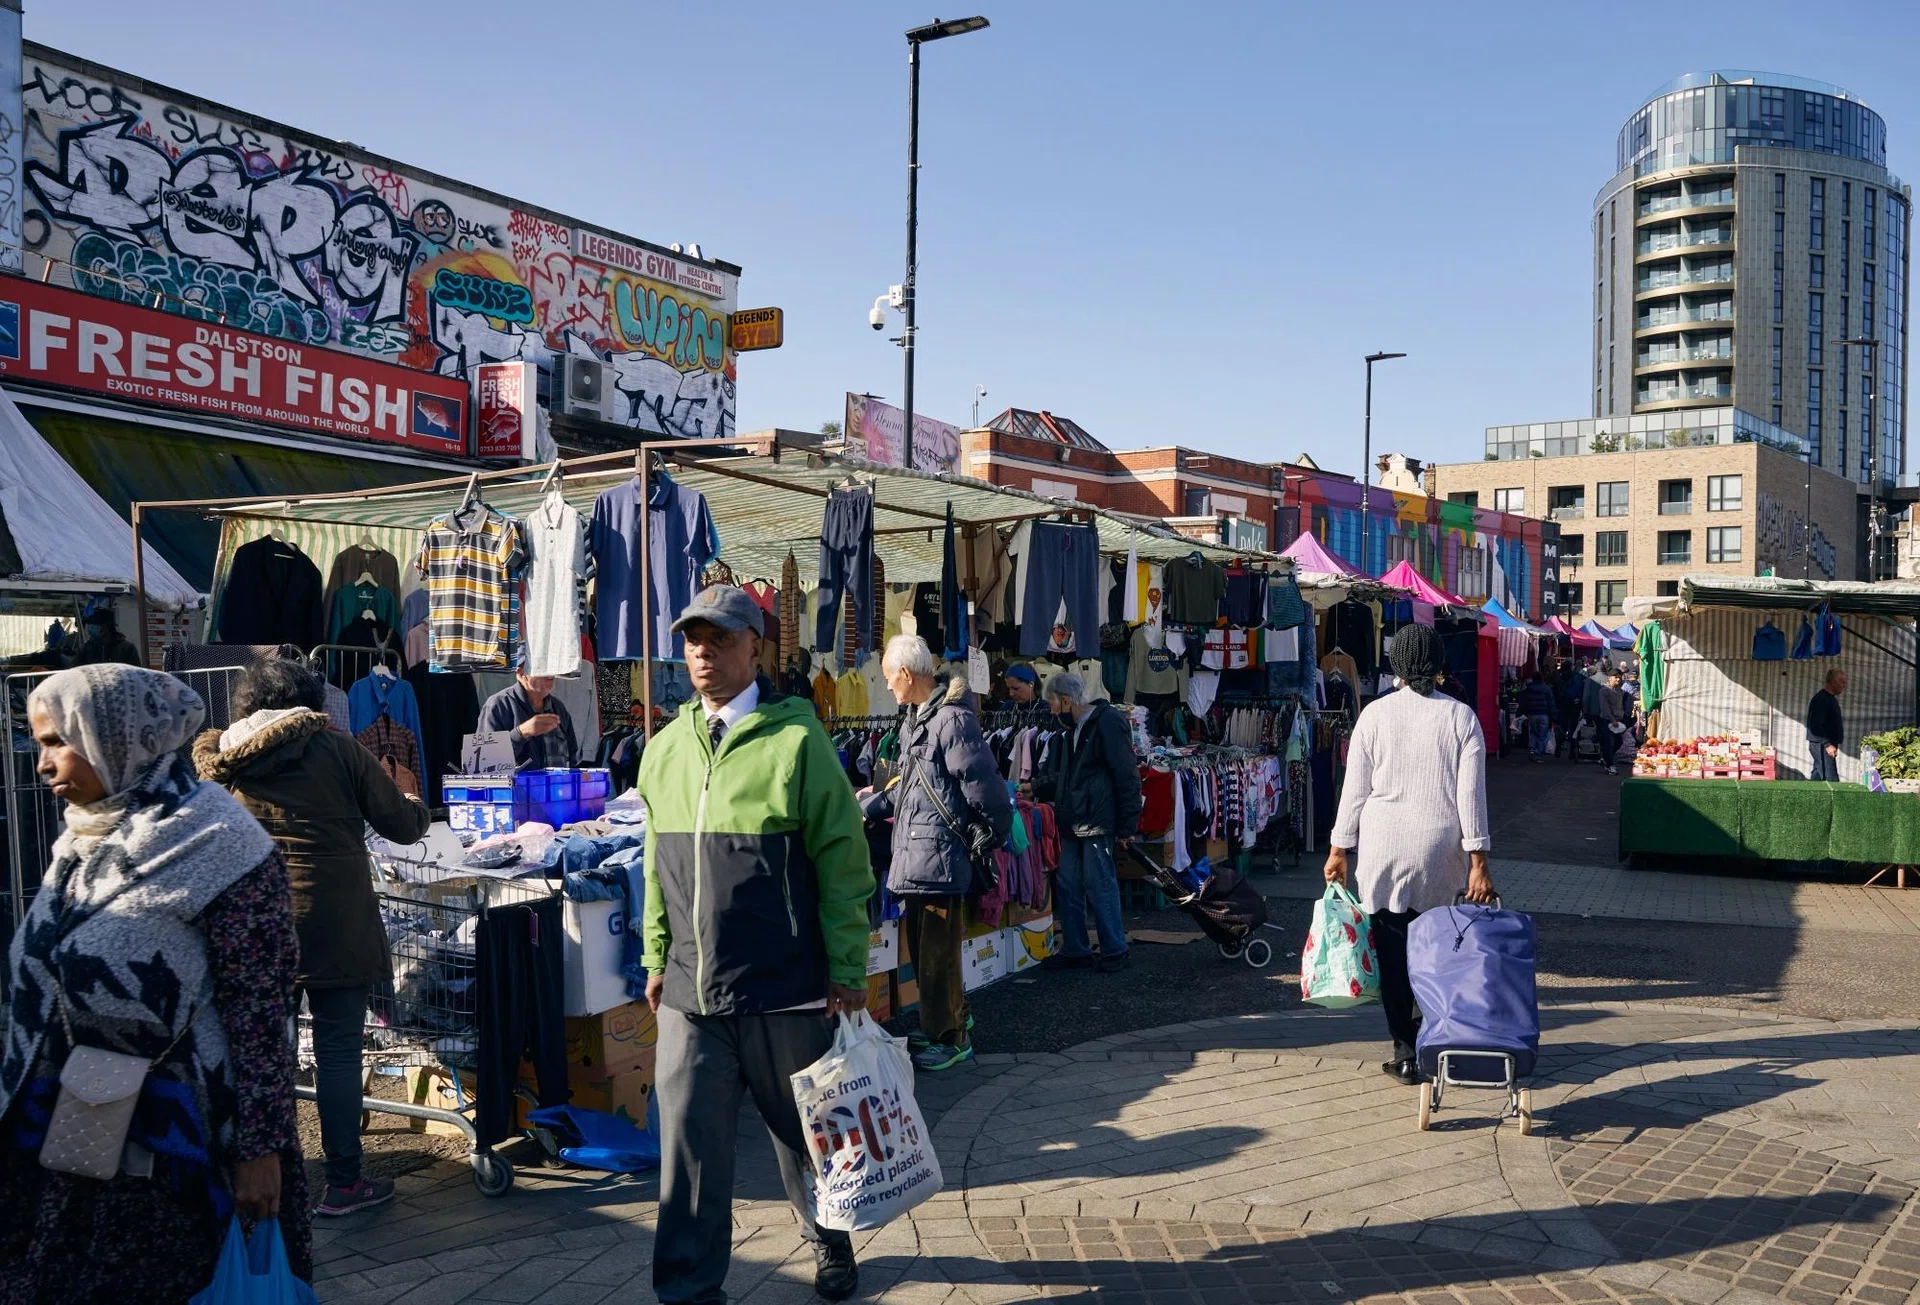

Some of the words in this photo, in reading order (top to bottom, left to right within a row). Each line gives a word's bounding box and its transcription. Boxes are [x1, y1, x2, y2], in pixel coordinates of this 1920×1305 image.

[582, 233, 643, 271] LEGENDS
[646, 255, 677, 282] GYM
[678, 276, 701, 288] FITNESS
[701, 280, 722, 295] CENTRE
[686, 265, 709, 280] HEALTH
[708, 273, 714, 282] &
[733, 310, 775, 326] LEGENDS
[195, 327, 302, 365] DALSTSON
[733, 322, 776, 347] GYM
[29, 309, 261, 398] FRESH
[285, 364, 408, 437] FISH
[481, 378, 520, 392] FRESH
[107, 379, 154, 397] EXOTIC
[158, 388, 198, 405] FRESH
[201, 396, 228, 410] FISH
[231, 402, 263, 416] FROM
[265, 408, 310, 425] AROUND
[313, 416, 333, 429] THE
[335, 421, 370, 436] WORLD
[481, 391, 520, 409] FISH
[837, 1074, 872, 1096] from
[887, 1149, 924, 1183] plastic
[838, 1194, 876, 1211] 100%
[879, 1167, 934, 1202] recyclable.
